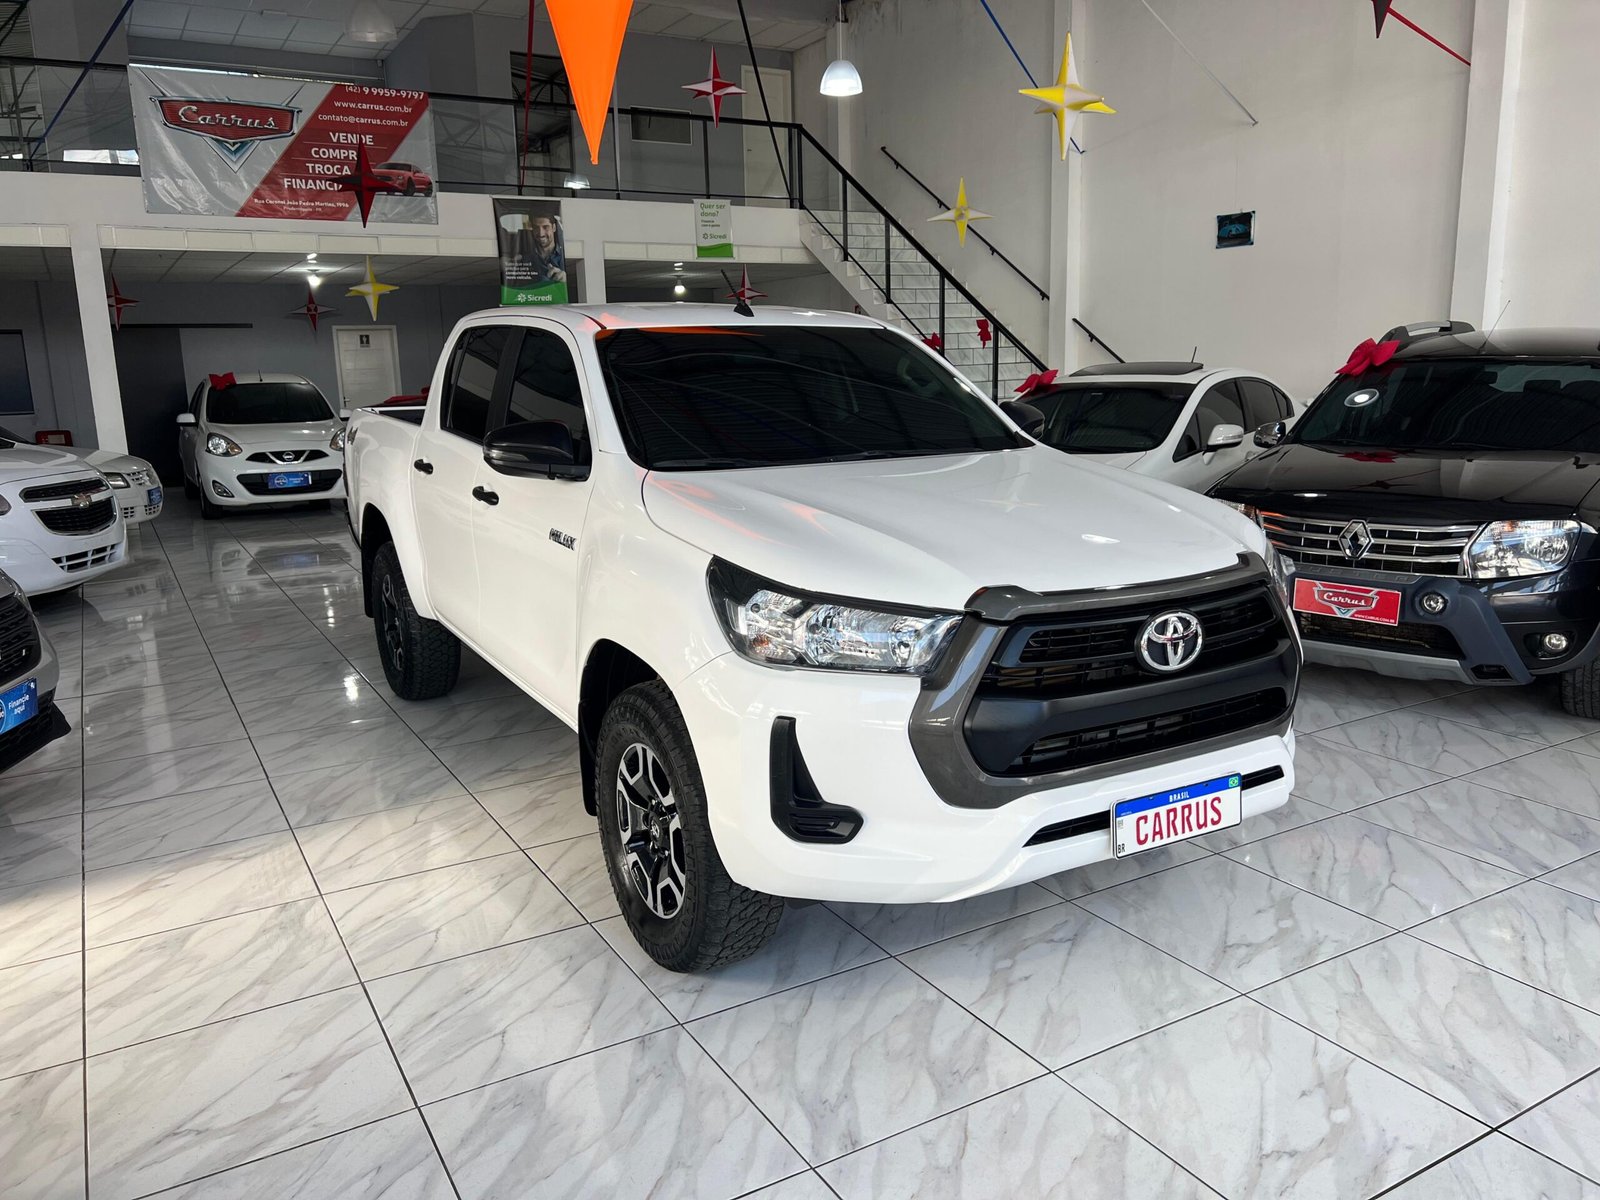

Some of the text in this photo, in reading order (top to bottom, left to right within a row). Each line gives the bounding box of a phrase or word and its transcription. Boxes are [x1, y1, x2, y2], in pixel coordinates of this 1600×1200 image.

[345, 85, 425, 100] (42) 9 9959-9797
[333, 100, 413, 113] www.carrus.com.br
[178, 105, 279, 130] Carrus
[318, 113, 409, 127] contato@carrus.com.br
[311, 147, 358, 161] COMPR
[305, 162, 352, 176] TROCA
[283, 177, 343, 192] FINANCI
[700, 203, 715, 211] Quer
[527, 294, 553, 302] Sicredi
[549, 527, 577, 551] HILUX
[1323, 592, 1367, 606] Carrus
[8, 693, 30, 710] Financie
[14, 702, 26, 715] aqui
[1169, 790, 1190, 803] BRASIL
[1135, 796, 1222, 846] CARRUS
[1117, 843, 1126, 855] BR
